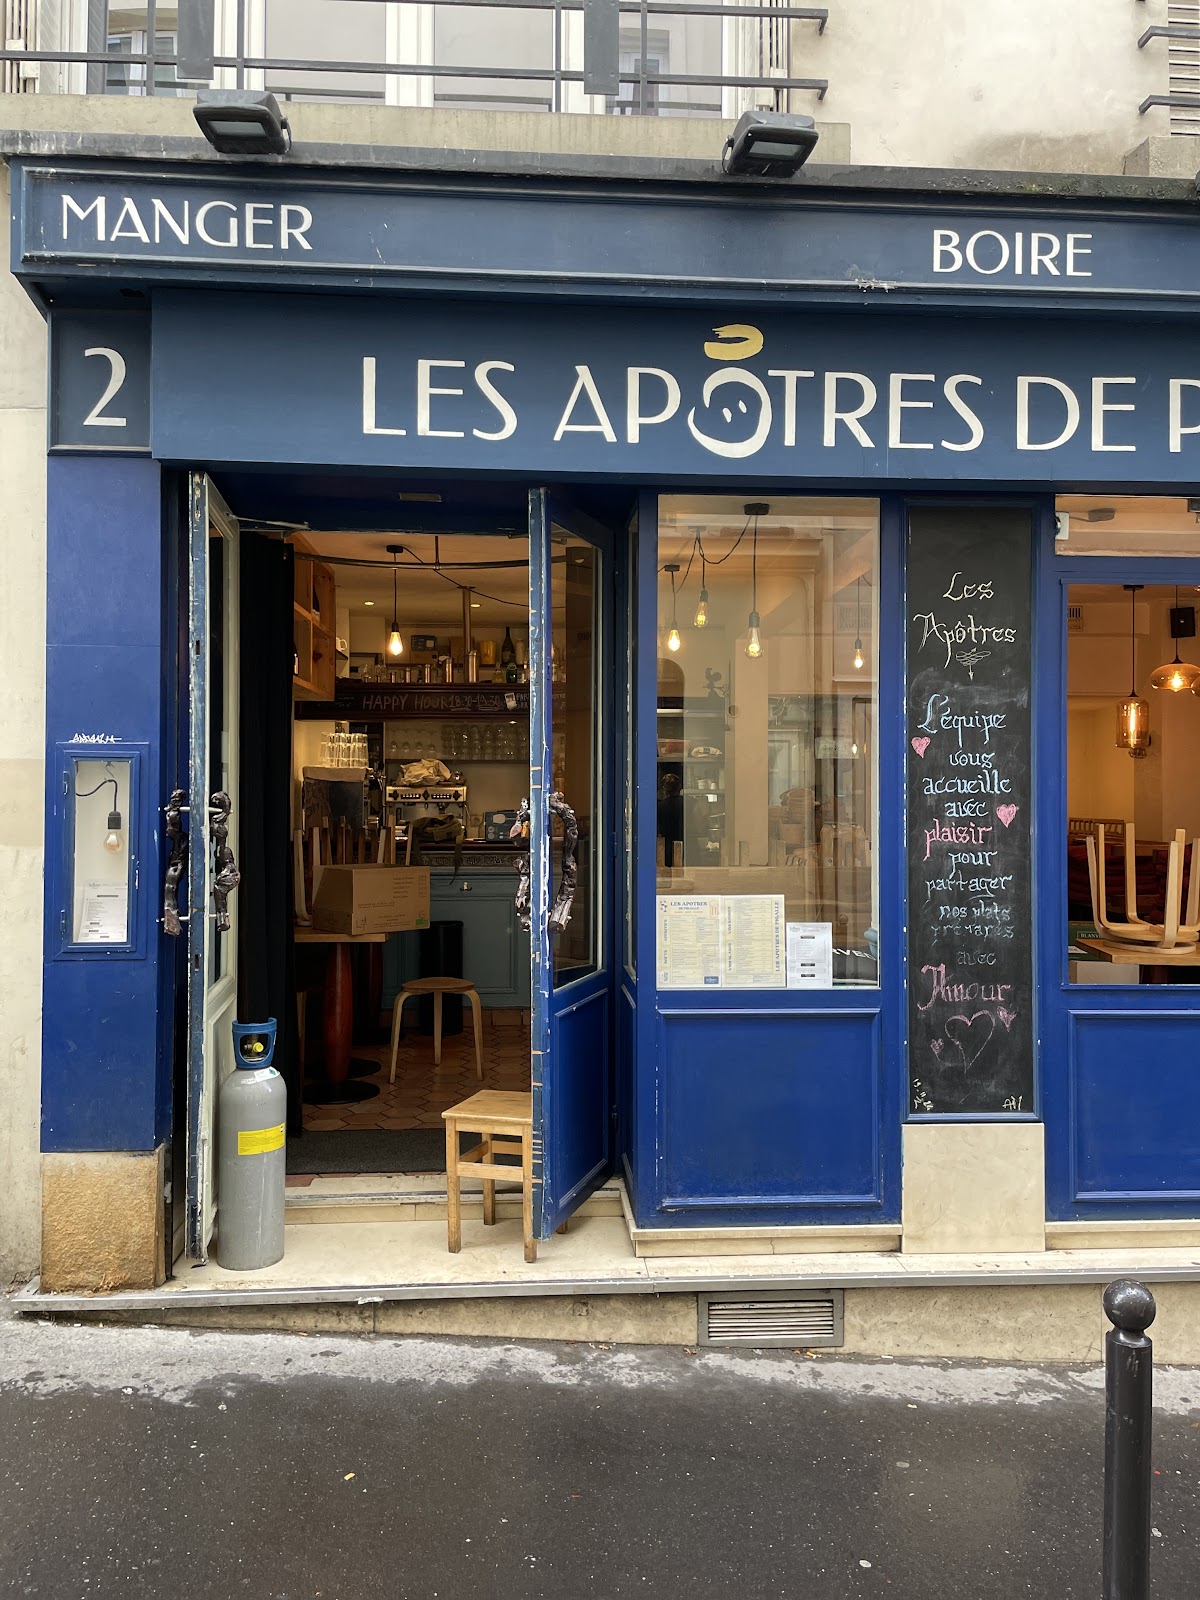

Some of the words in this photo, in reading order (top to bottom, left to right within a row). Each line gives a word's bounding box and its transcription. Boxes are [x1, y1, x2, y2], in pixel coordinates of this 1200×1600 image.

[61, 194, 313, 250] MANGER
[932, 229, 1093, 277] BOIRE
[83, 347, 127, 427] 2
[363, 356, 518, 441] LES
[1017, 376, 1136, 452] DE
[943, 571, 994, 601] Les
[913, 612, 1017, 669] Apôtres
[362, 694, 409, 711] HAPPY
[414, 695, 449, 711] HOUR
[922, 769, 1012, 795] accueille
[949, 751, 996, 769] vous
[944, 799, 989, 817] avec
[923, 818, 993, 862] plaisir
[948, 851, 997, 879] pour
[917, 963, 1012, 1011] Amour
